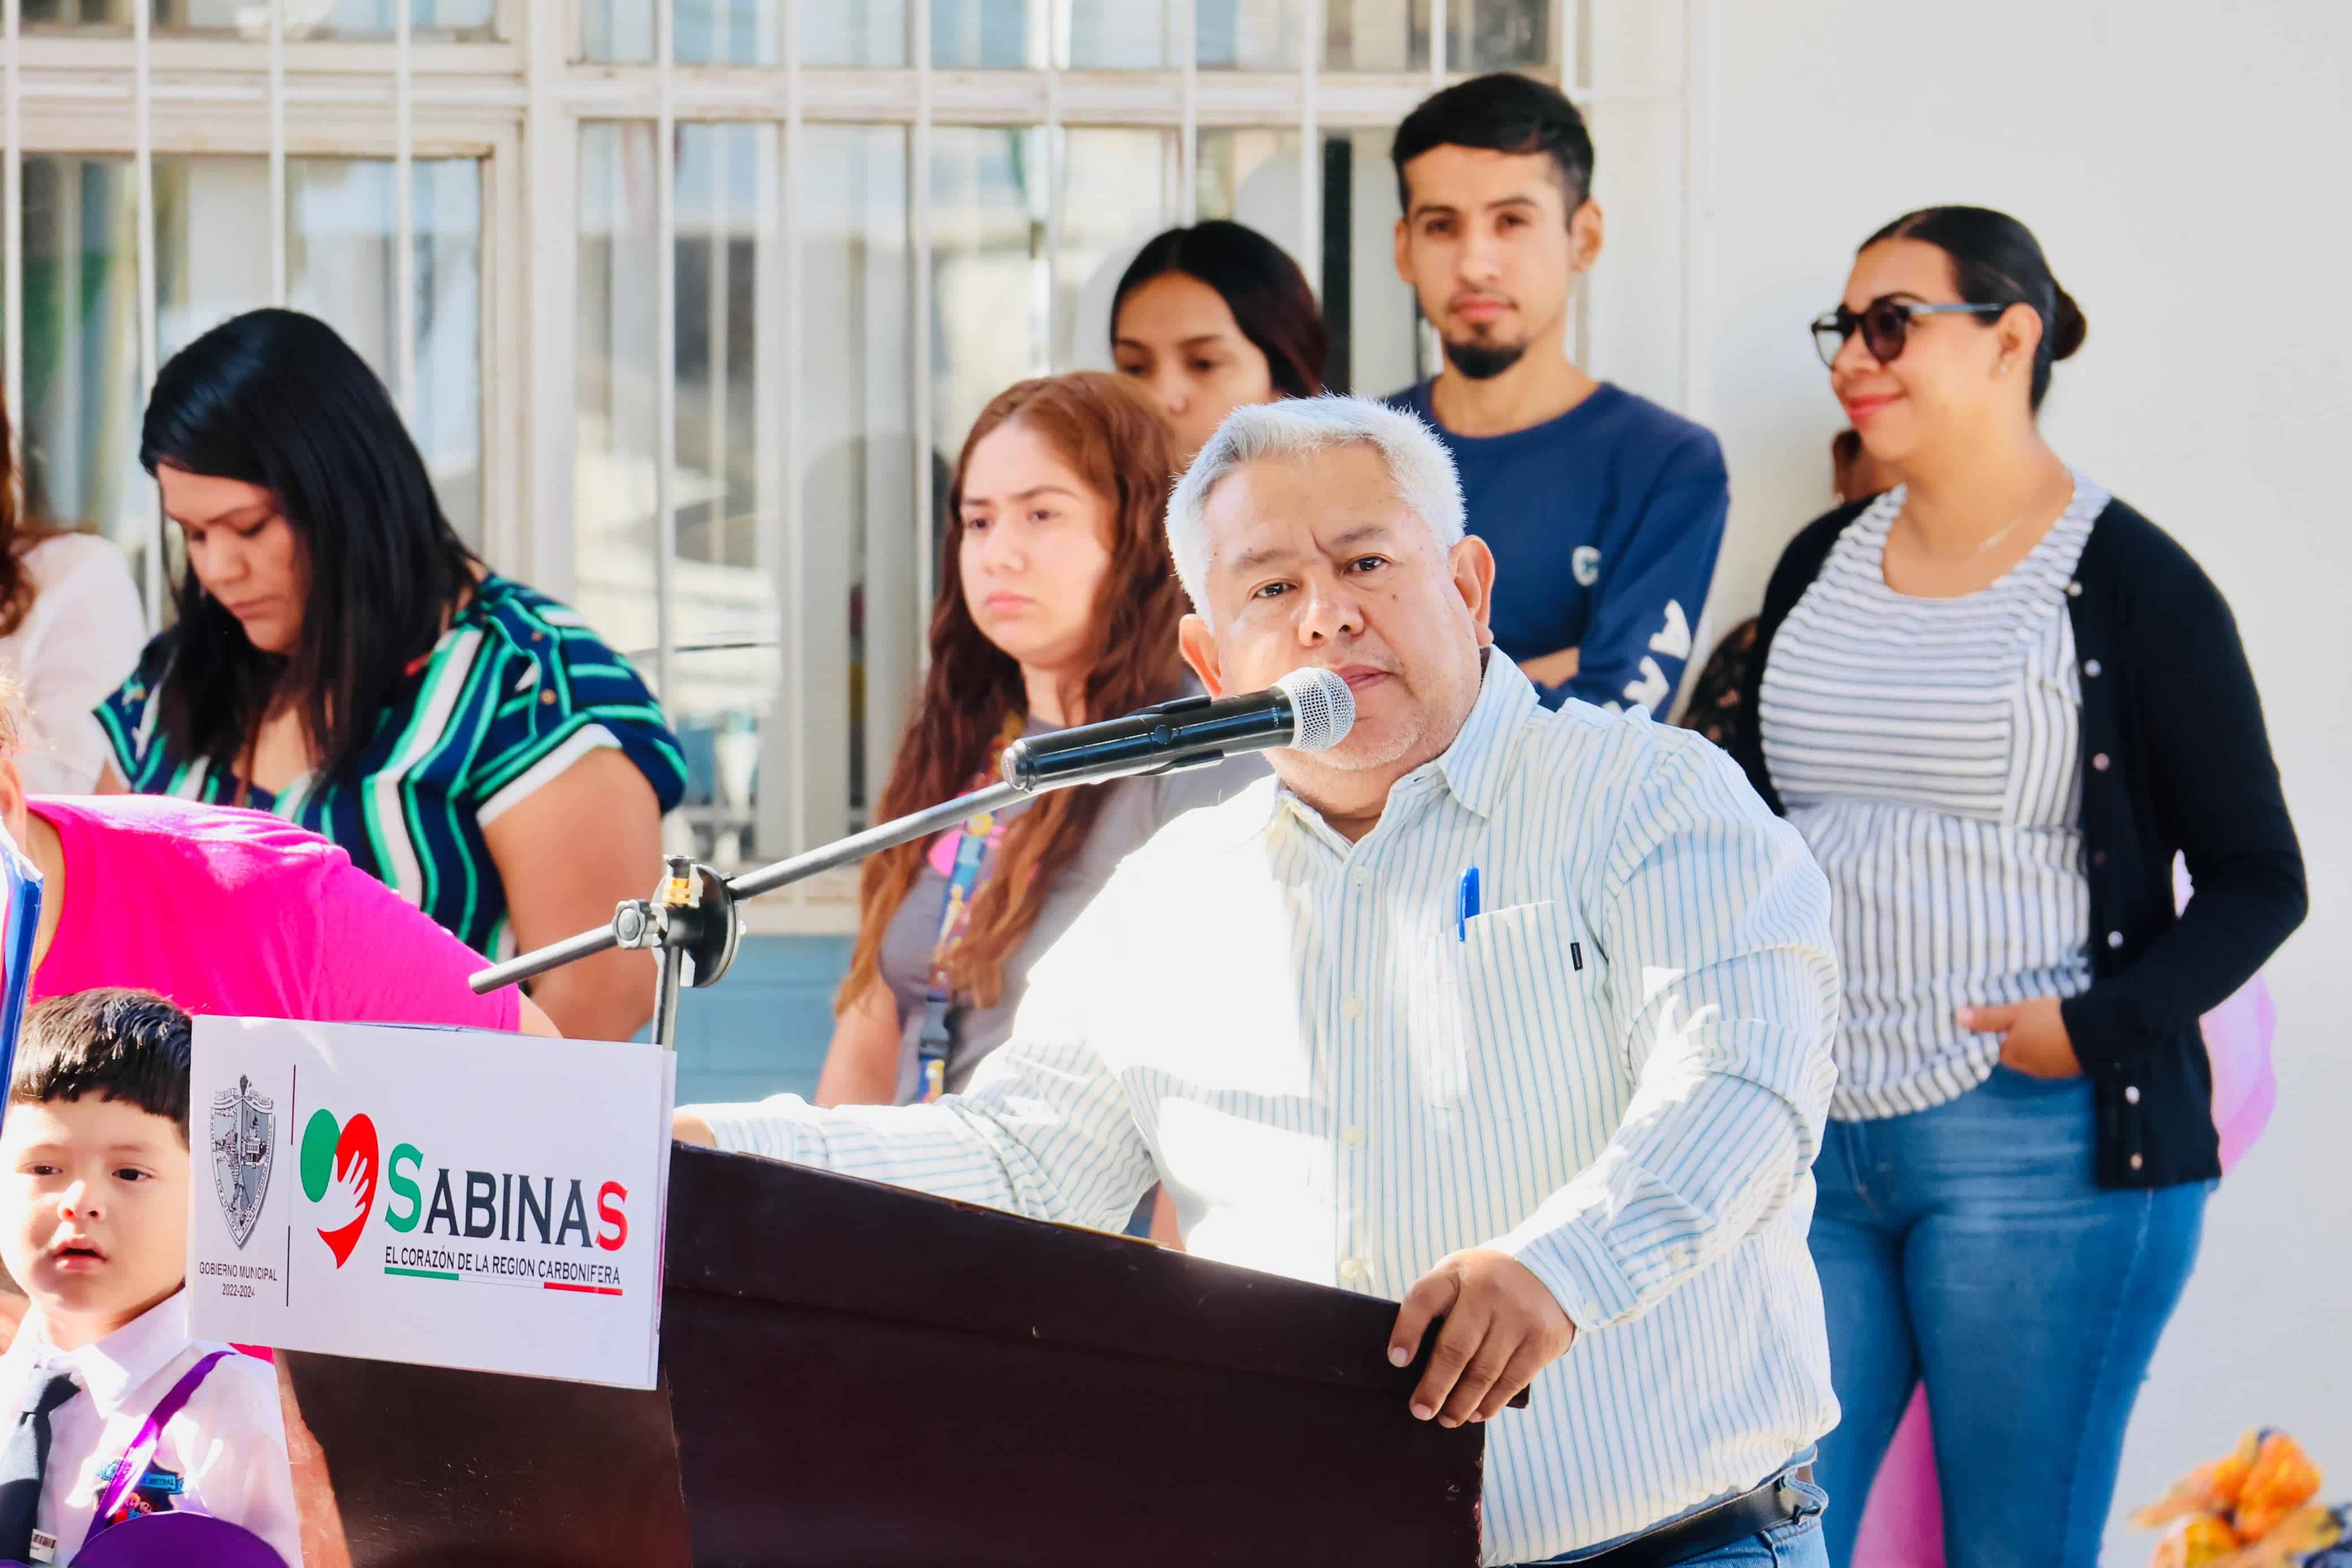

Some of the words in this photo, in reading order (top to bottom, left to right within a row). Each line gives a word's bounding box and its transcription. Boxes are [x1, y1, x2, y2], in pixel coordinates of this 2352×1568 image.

[385, 1143, 629, 1251] SABINAS
[199, 1261, 237, 1277] GOBIERNO
[239, 1266, 278, 1281] MUNICIPAL
[385, 1245, 399, 1264] EL
[401, 1245, 455, 1270] CORAZÓN
[458, 1253, 472, 1271] DE
[475, 1254, 489, 1272] LA
[492, 1255, 535, 1277] REGION
[538, 1260, 621, 1285] CARBONIFERA
[222, 1283, 255, 1298] 2022-2024
